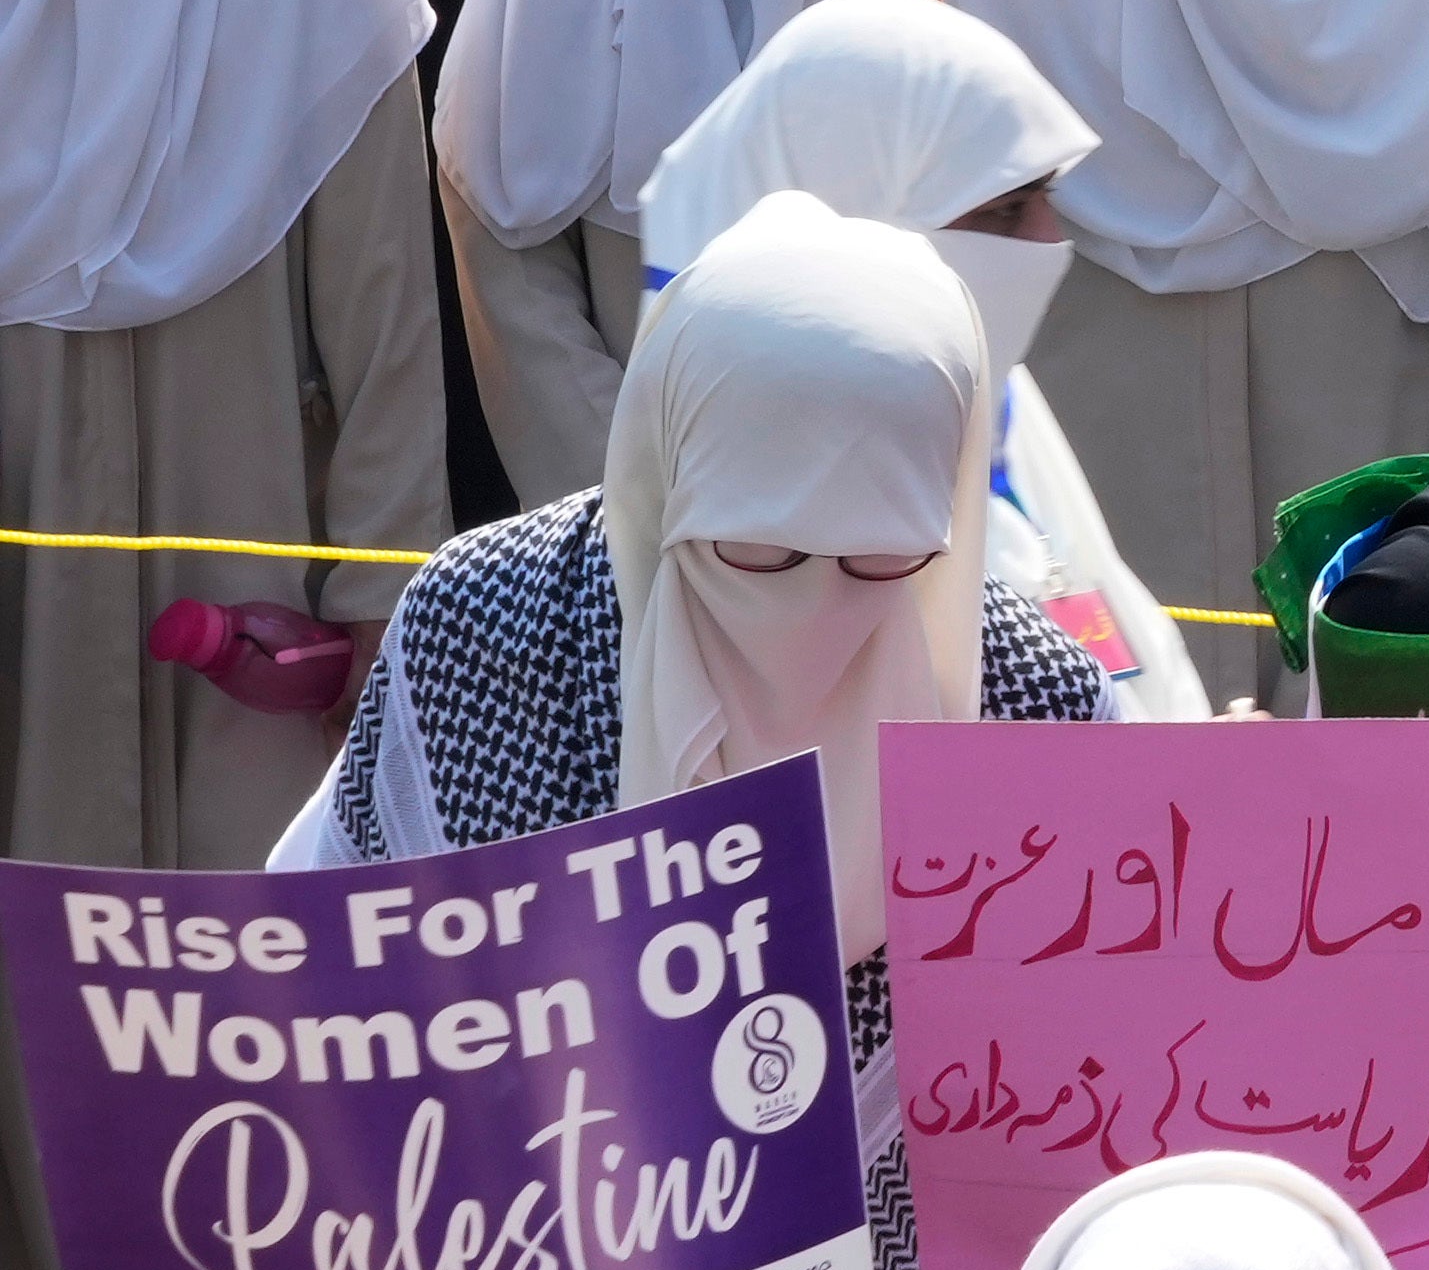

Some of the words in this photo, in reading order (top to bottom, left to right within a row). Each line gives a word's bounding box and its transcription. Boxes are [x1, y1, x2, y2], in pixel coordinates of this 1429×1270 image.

[62, 891, 309, 973] Rise
[346, 881, 538, 970] For
[566, 822, 764, 925] The
[1213, 815, 1423, 982] مال
[81, 976, 595, 1084] Women
[638, 897, 772, 1021] Of
